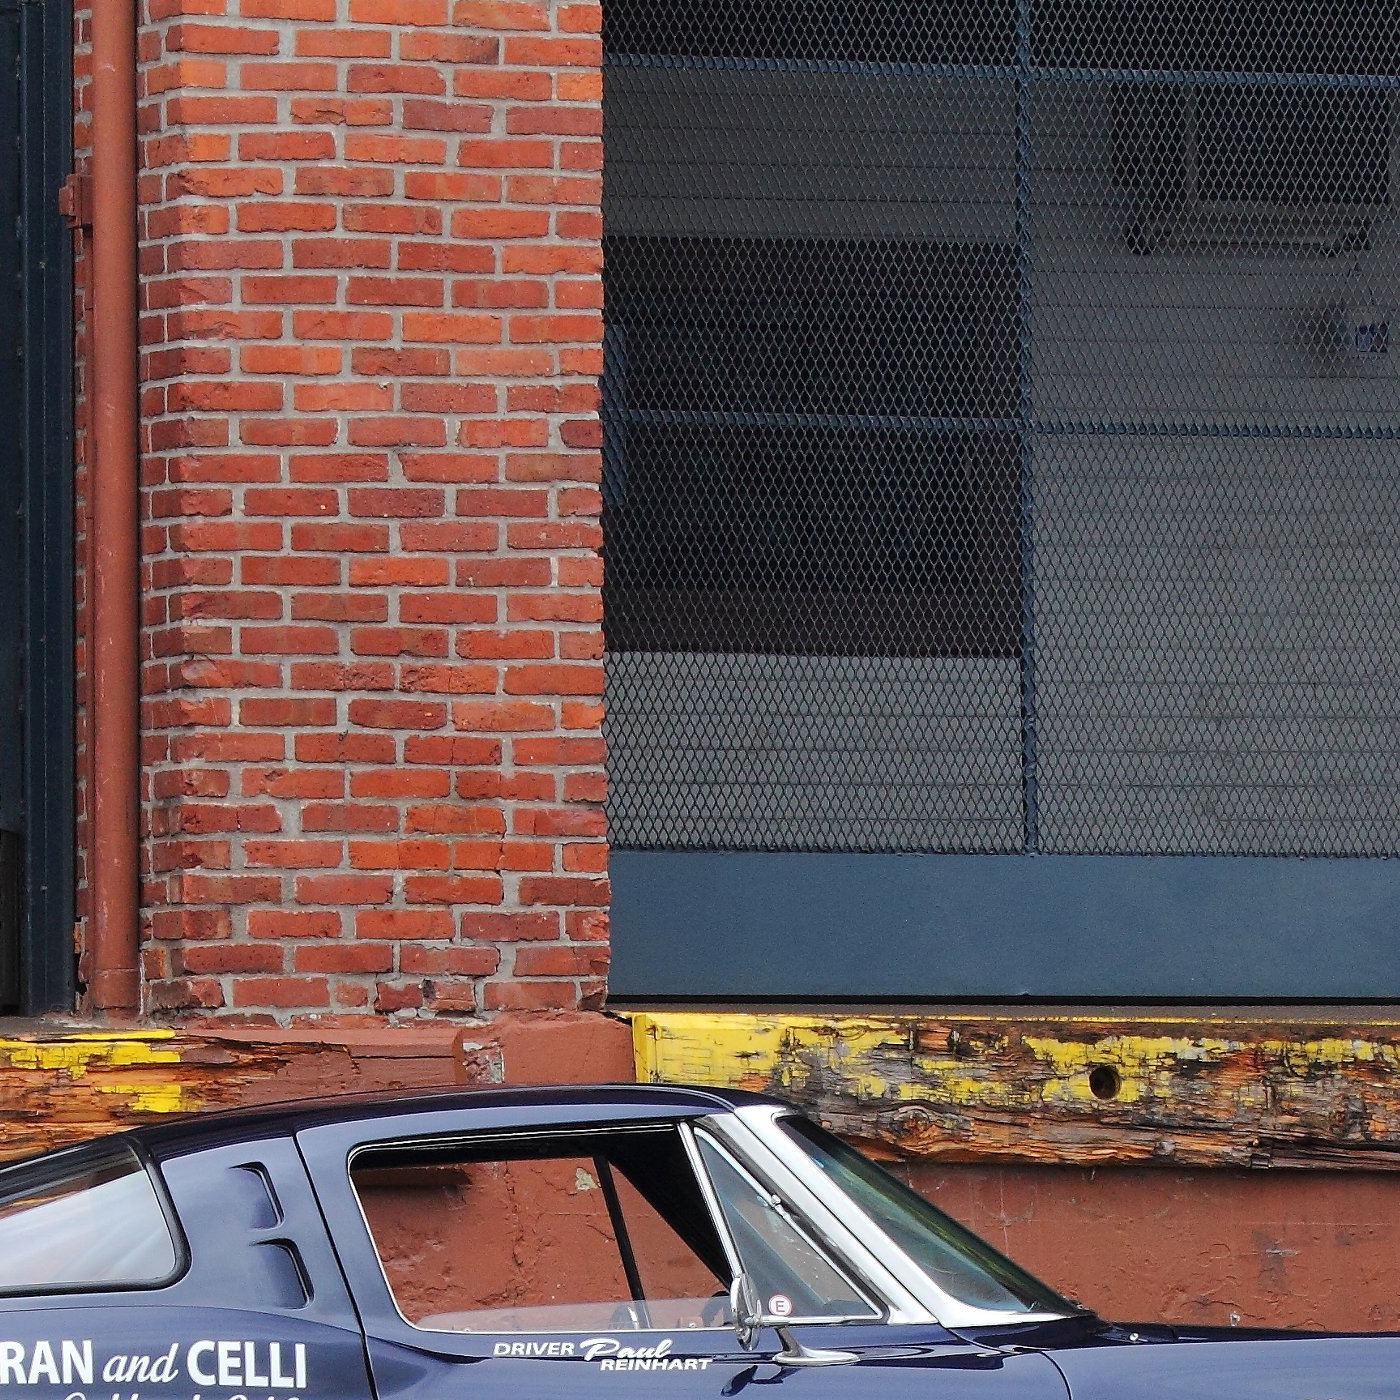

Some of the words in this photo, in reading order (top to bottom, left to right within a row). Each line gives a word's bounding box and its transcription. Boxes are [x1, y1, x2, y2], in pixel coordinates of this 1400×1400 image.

[492, 1341, 575, 1357] DRIVER
[579, 1337, 674, 1362] Paul
[102, 1342, 180, 1385] and
[185, 1339, 307, 1389] CELLI
[599, 1357, 713, 1372] REINHART
